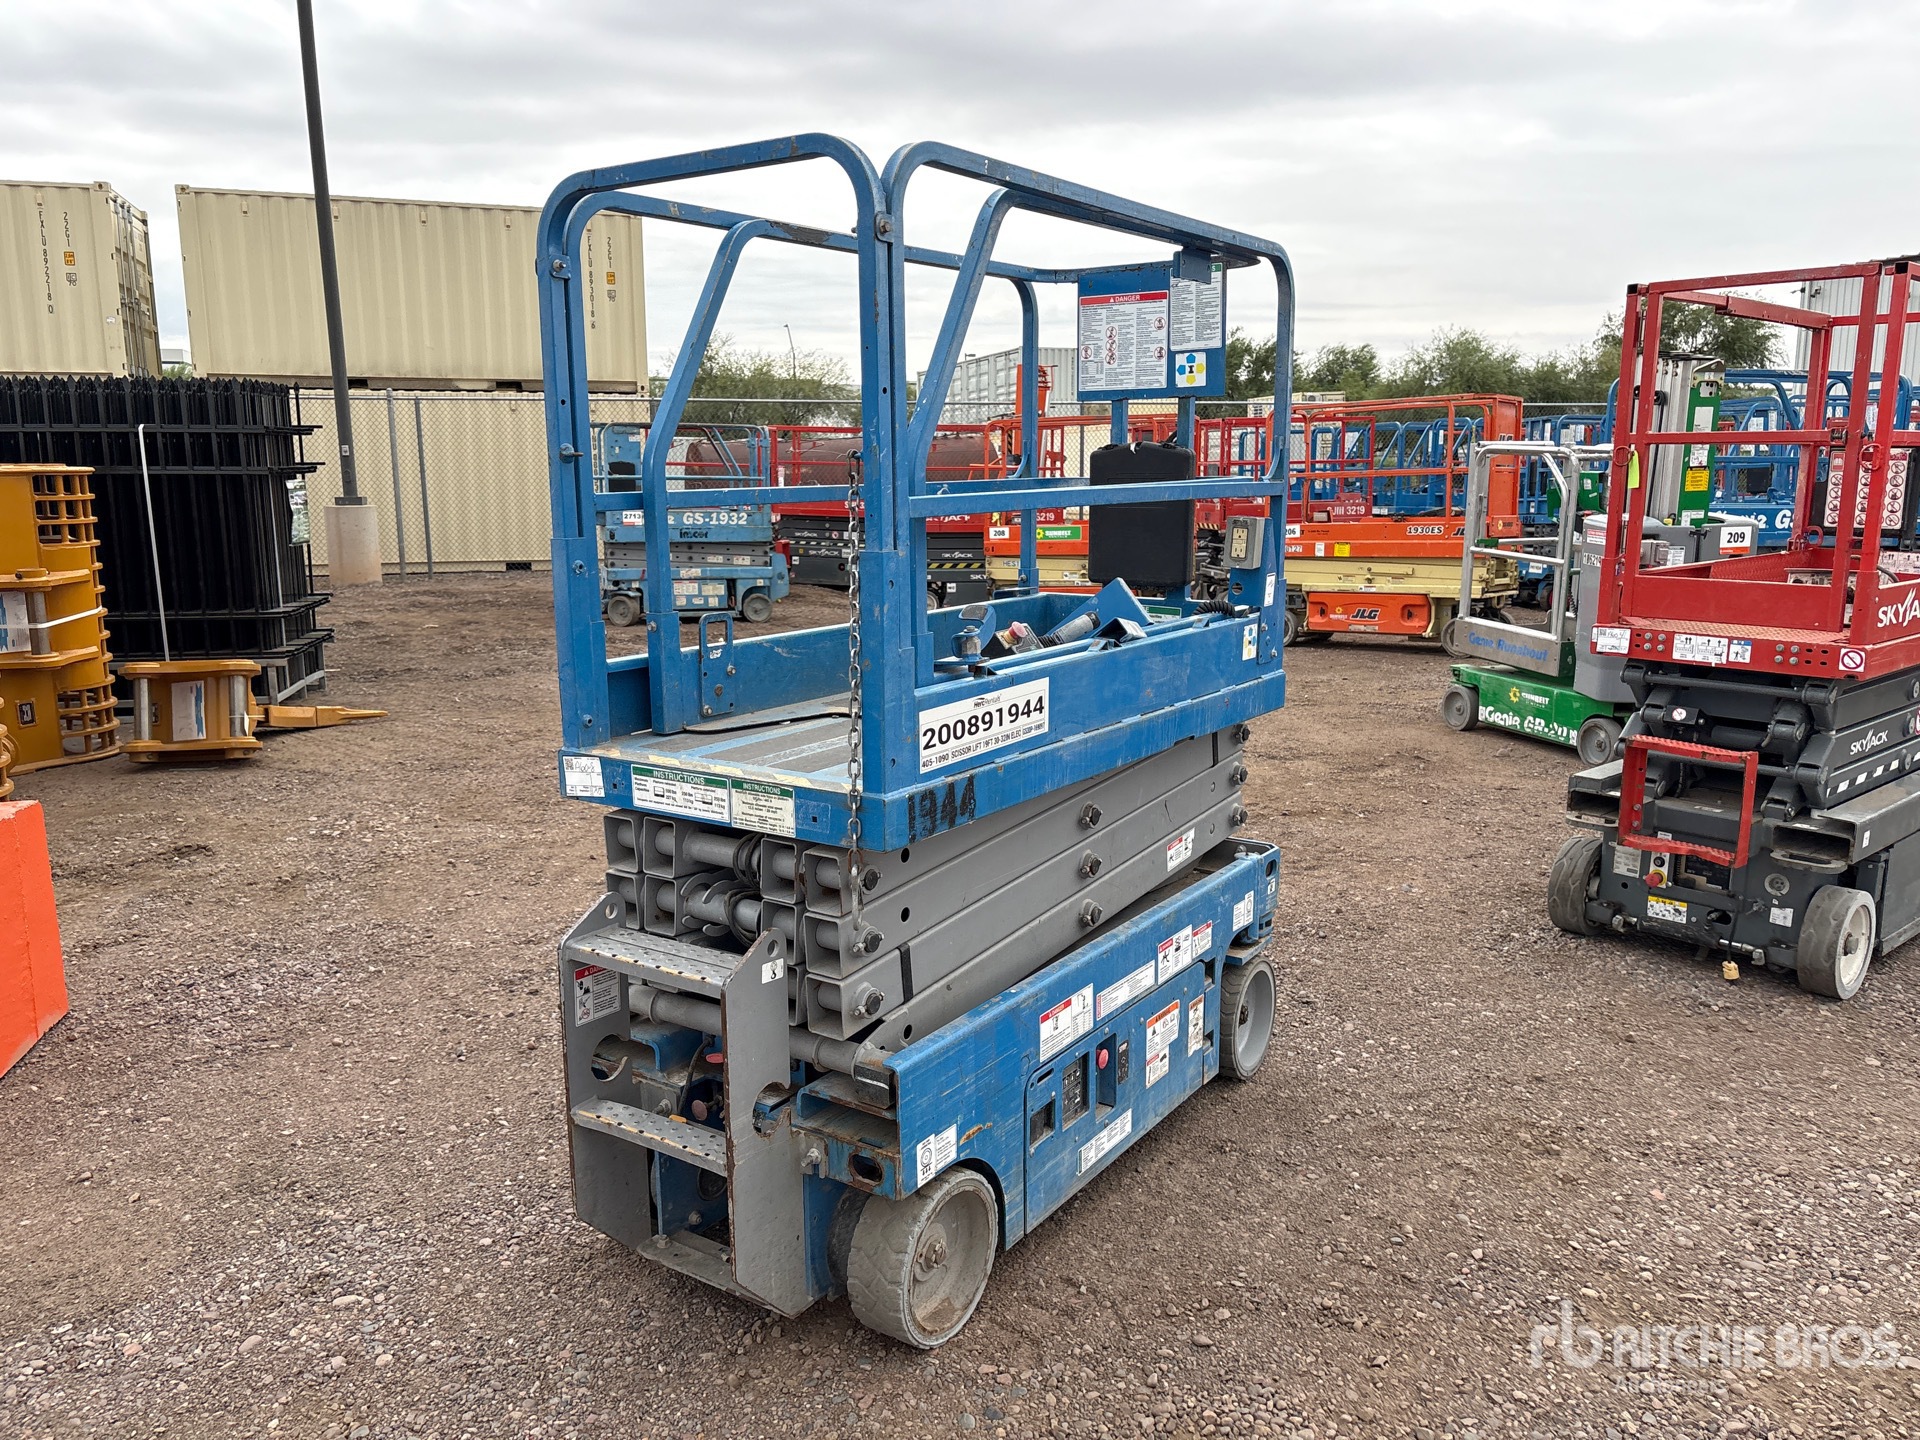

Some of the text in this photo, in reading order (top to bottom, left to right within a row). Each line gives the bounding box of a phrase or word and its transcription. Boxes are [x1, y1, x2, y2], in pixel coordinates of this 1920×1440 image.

[38, 211, 47, 247] FXLU
[63, 211, 71, 247] 22G1
[42, 249, 52, 301] 892218
[1115, 294, 1140, 302] DANGER
[683, 512, 748, 525] GS-1932
[1346, 505, 1366, 515] 3219
[1407, 526, 1444, 535] 1930ES
[1727, 532, 1746, 544] 209
[1351, 608, 1379, 619] JLG
[1468, 632, 1549, 661] Genie Runabout
[922, 695, 1045, 751] 200891944
[1486, 705, 1521, 729] Genie
[1850, 728, 1888, 756] SKYJACK
[922, 753, 950, 768] 405-1090
[951, 745, 972, 758] SCISSOR
[972, 741, 982, 752] LIFT
[653, 770, 705, 785] INSTRUCTIONS
[742, 782, 781, 795] INSTRUCTIONS
[908, 774, 977, 843] 1944
